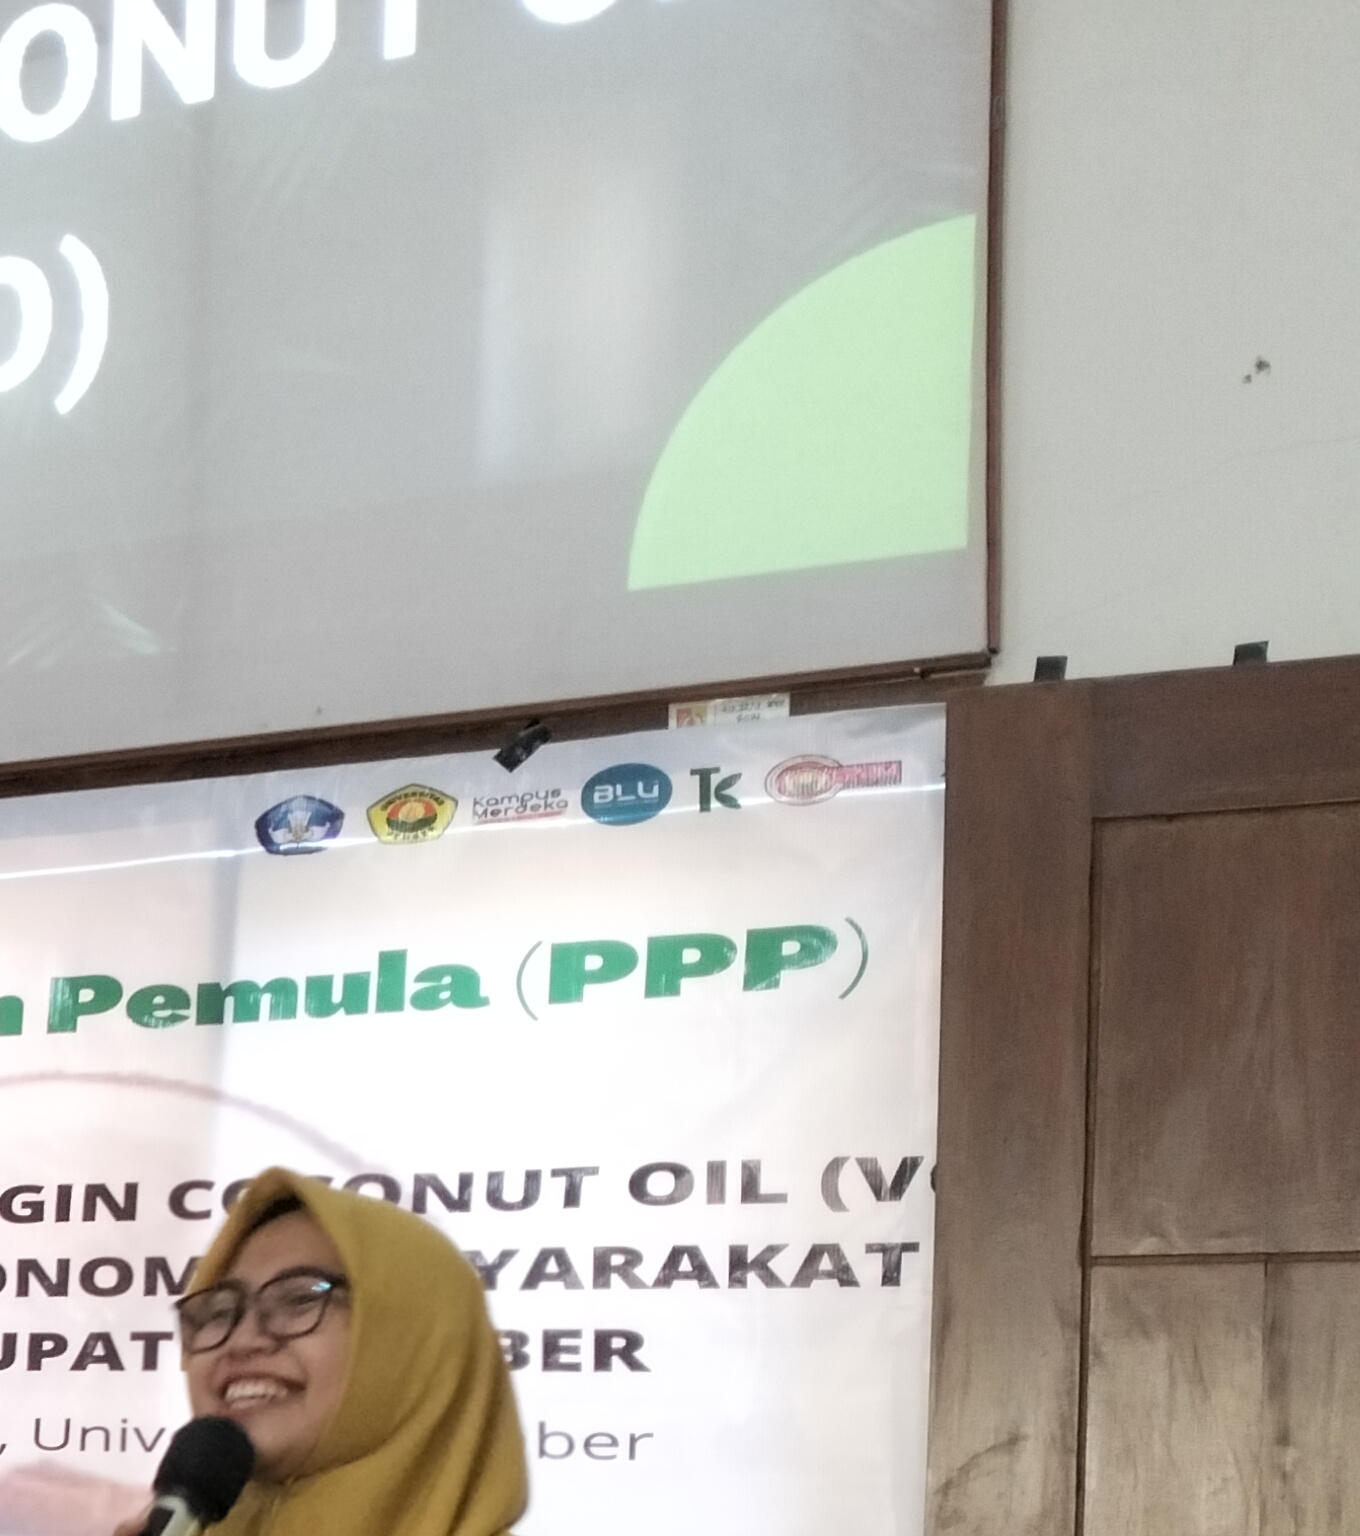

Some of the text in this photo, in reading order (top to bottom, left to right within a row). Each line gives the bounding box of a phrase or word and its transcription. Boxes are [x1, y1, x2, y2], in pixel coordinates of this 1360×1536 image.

[593, 780, 660, 804] BLU
[46, 949, 490, 1035] Pemula
[516, 917, 869, 1021] (PPP)
[167, 1166, 600, 1221] CONUT
[627, 1159, 788, 1207] OIL
[469, 1241, 921, 1291] YARAKAT
[495, 1328, 652, 1373] BER
[537, 1420, 655, 1461] ber
